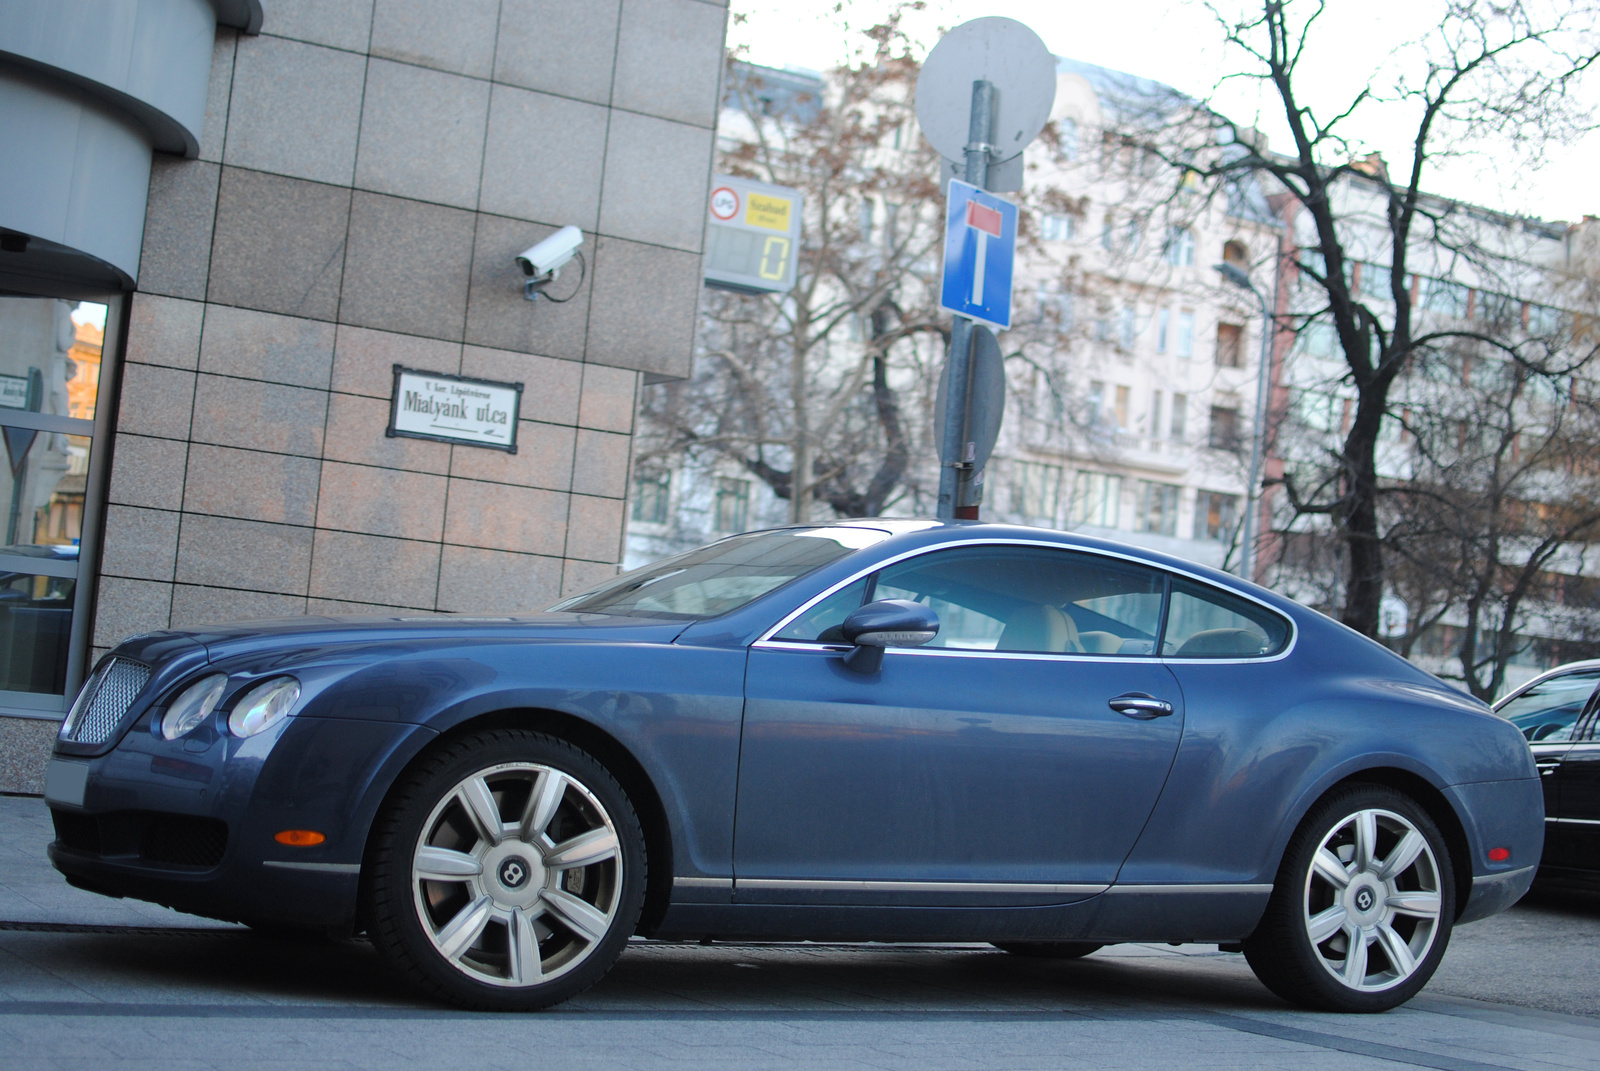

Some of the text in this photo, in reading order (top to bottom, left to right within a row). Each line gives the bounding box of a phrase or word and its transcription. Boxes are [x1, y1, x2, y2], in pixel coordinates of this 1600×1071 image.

[714, 197, 734, 210] LPG
[760, 236, 789, 280] 0
[403, 390, 508, 425] Miatyánk utca
